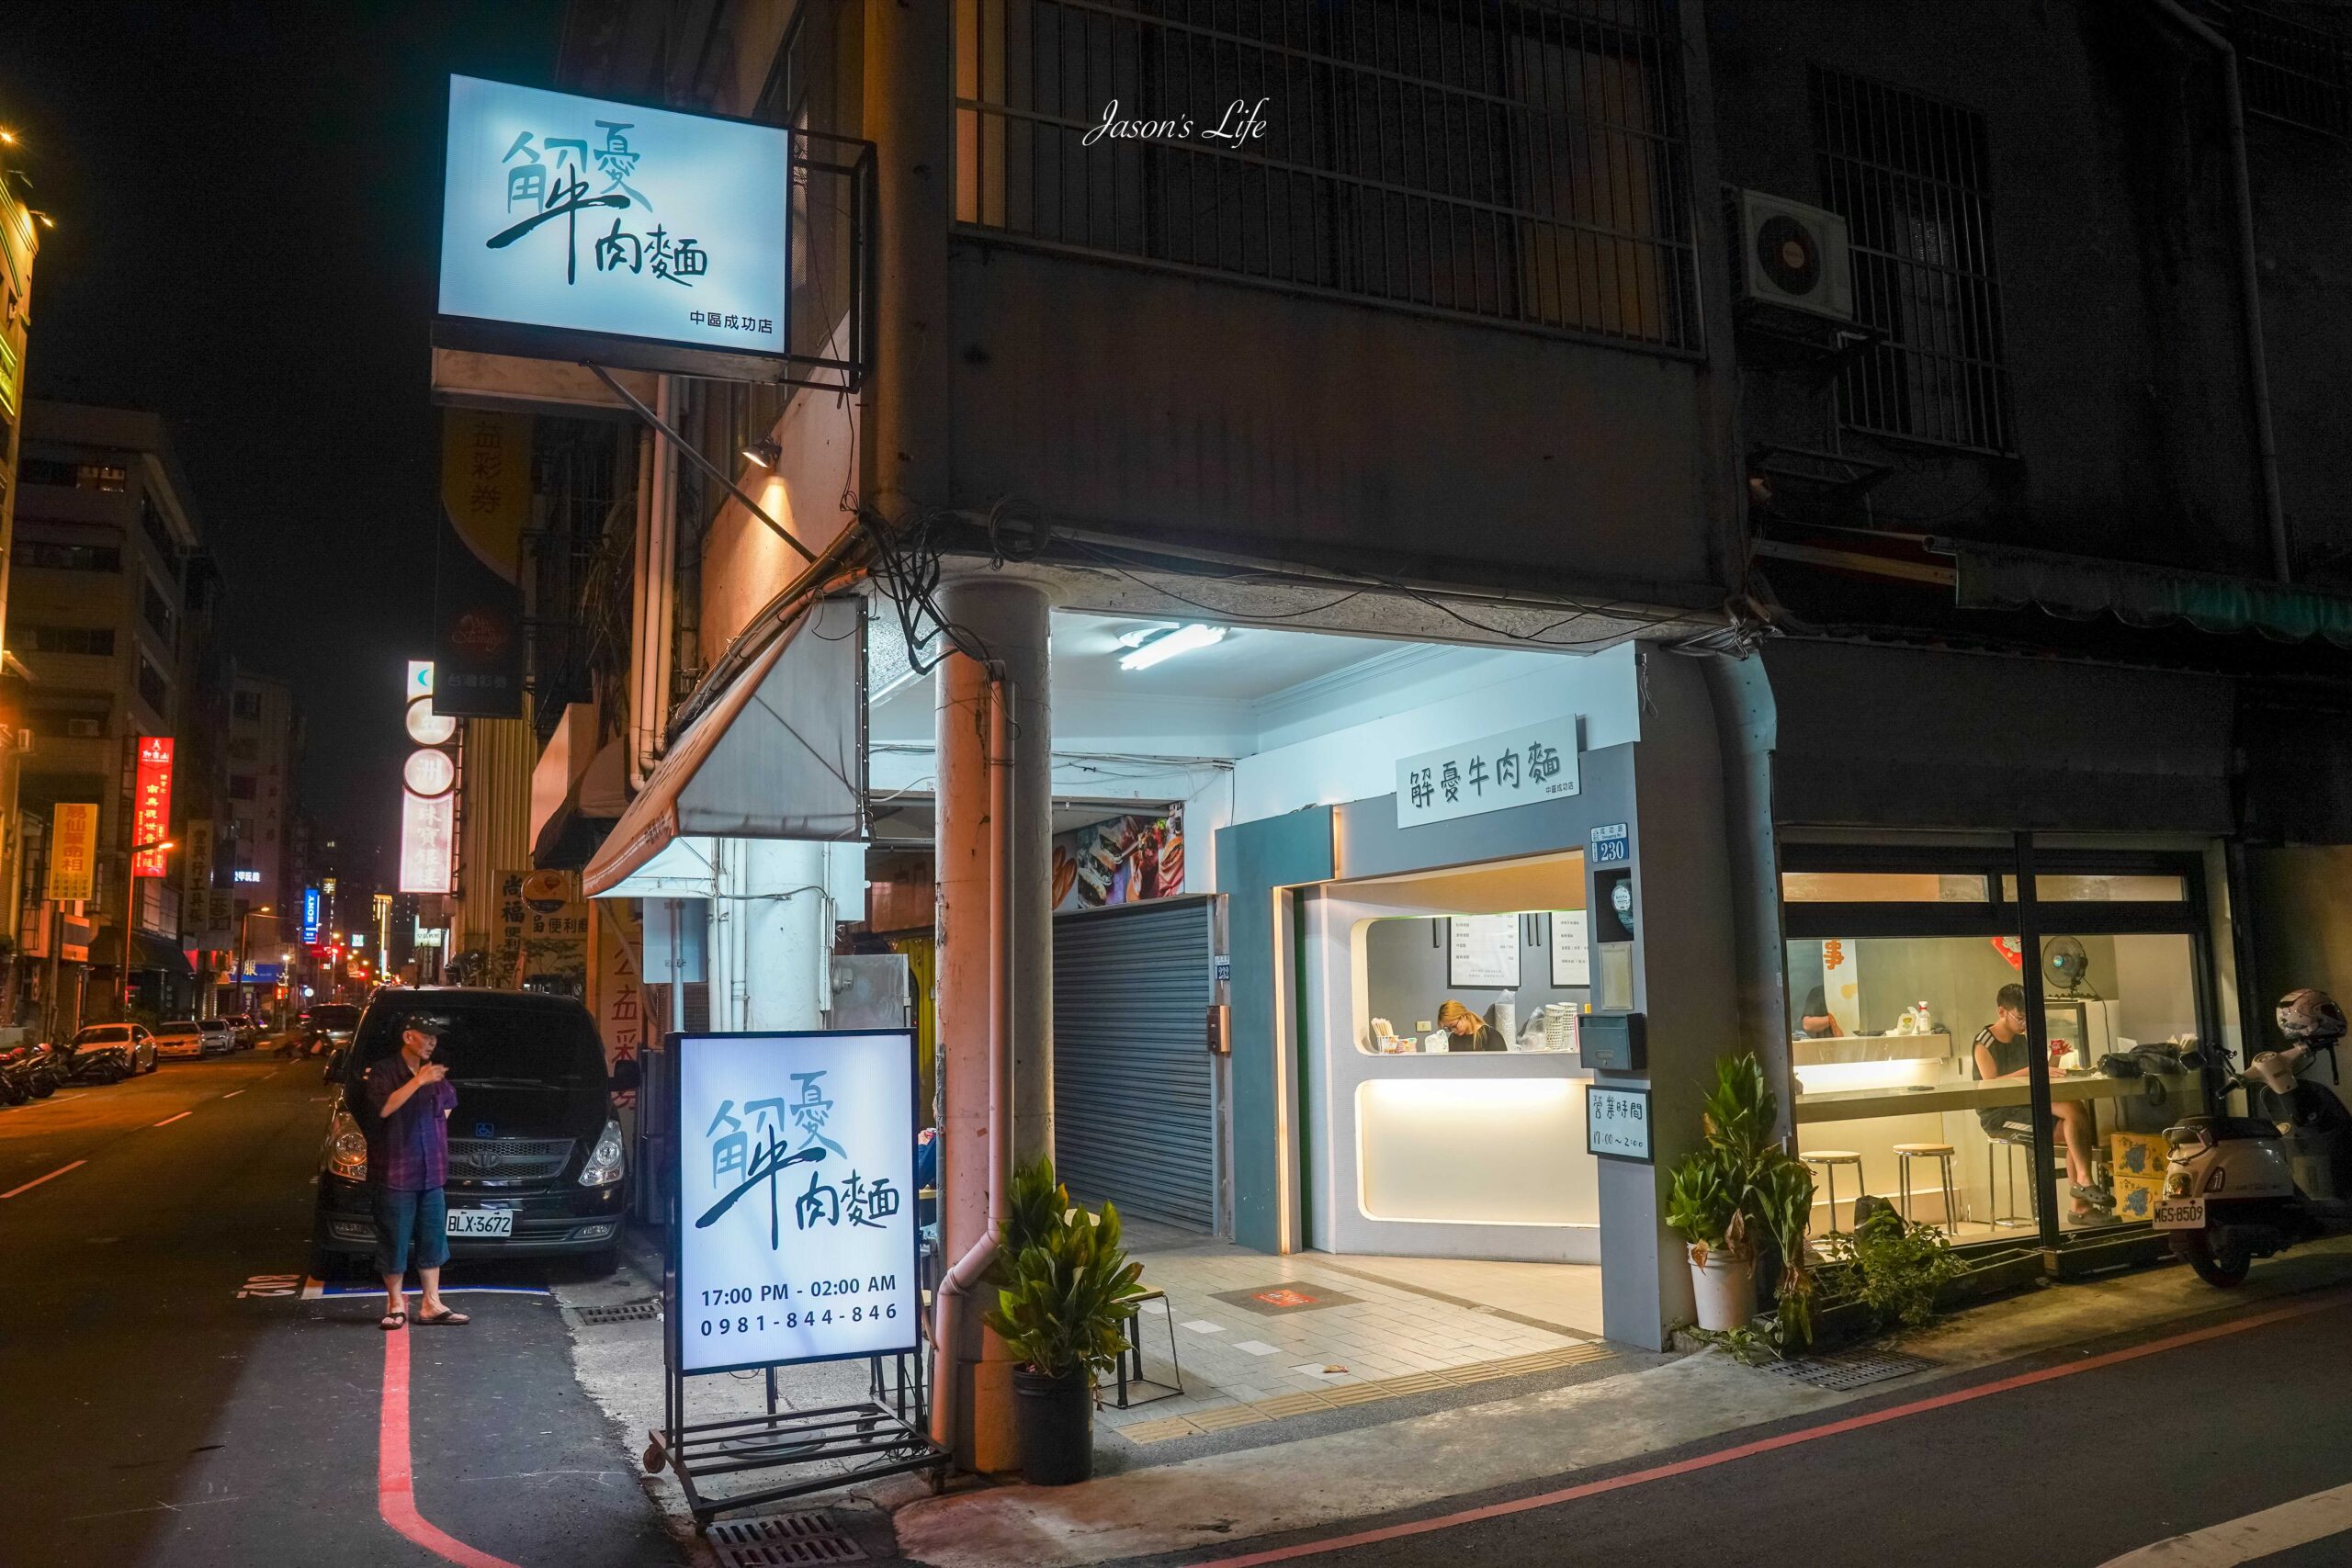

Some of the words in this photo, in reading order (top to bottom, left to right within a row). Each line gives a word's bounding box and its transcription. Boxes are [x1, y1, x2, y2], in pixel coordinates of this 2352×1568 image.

[689, 310, 773, 334] 中區成功店
[470, 411, 502, 513] 益彩券
[1409, 740, 1561, 808] 解憂牛肉麵
[1545, 781, 1574, 795] 中區成功店
[1600, 840, 1623, 861] 230
[307, 895, 315, 923] SONY
[1593, 1094, 1643, 1120] 營業時間
[447, 1215, 511, 1233] BLX-3672
[2154, 1205, 2203, 1223] MGS-8509
[702, 1287, 752, 1306] 17:00
[762, 1284, 788, 1302] PM
[810, 1278, 860, 1298] 02:00
[867, 1274, 897, 1292] AM
